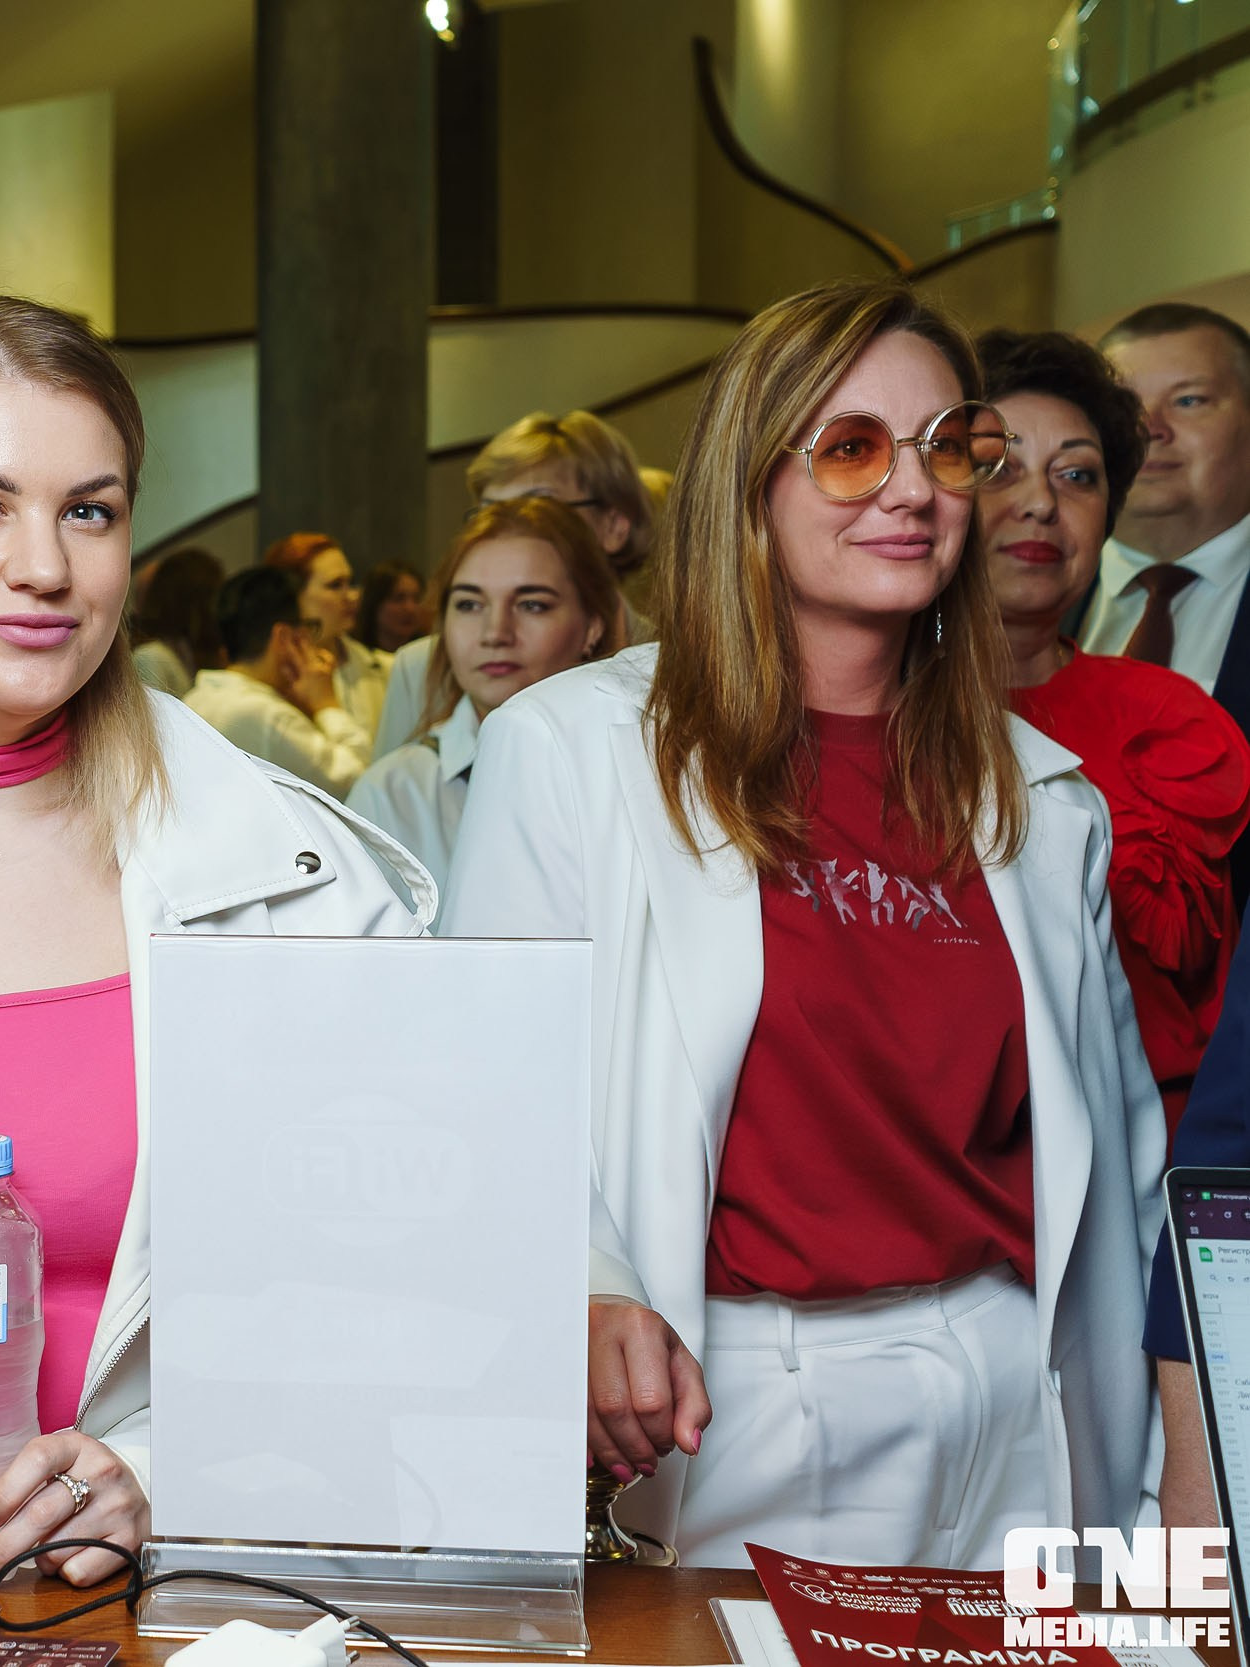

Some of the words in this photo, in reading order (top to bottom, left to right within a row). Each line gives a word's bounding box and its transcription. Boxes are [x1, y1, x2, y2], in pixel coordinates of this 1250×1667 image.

[834, 1590, 922, 1603] БАЛТИЙСКИЙ
[837, 1596, 922, 1608] КУЛЬТУРНЫЙ
[840, 1602, 888, 1612] ФОРУМ
[947, 1601, 1039, 1618] ПОБЕДЫ
[810, 1628, 1078, 1666] ПРОГРАММА
